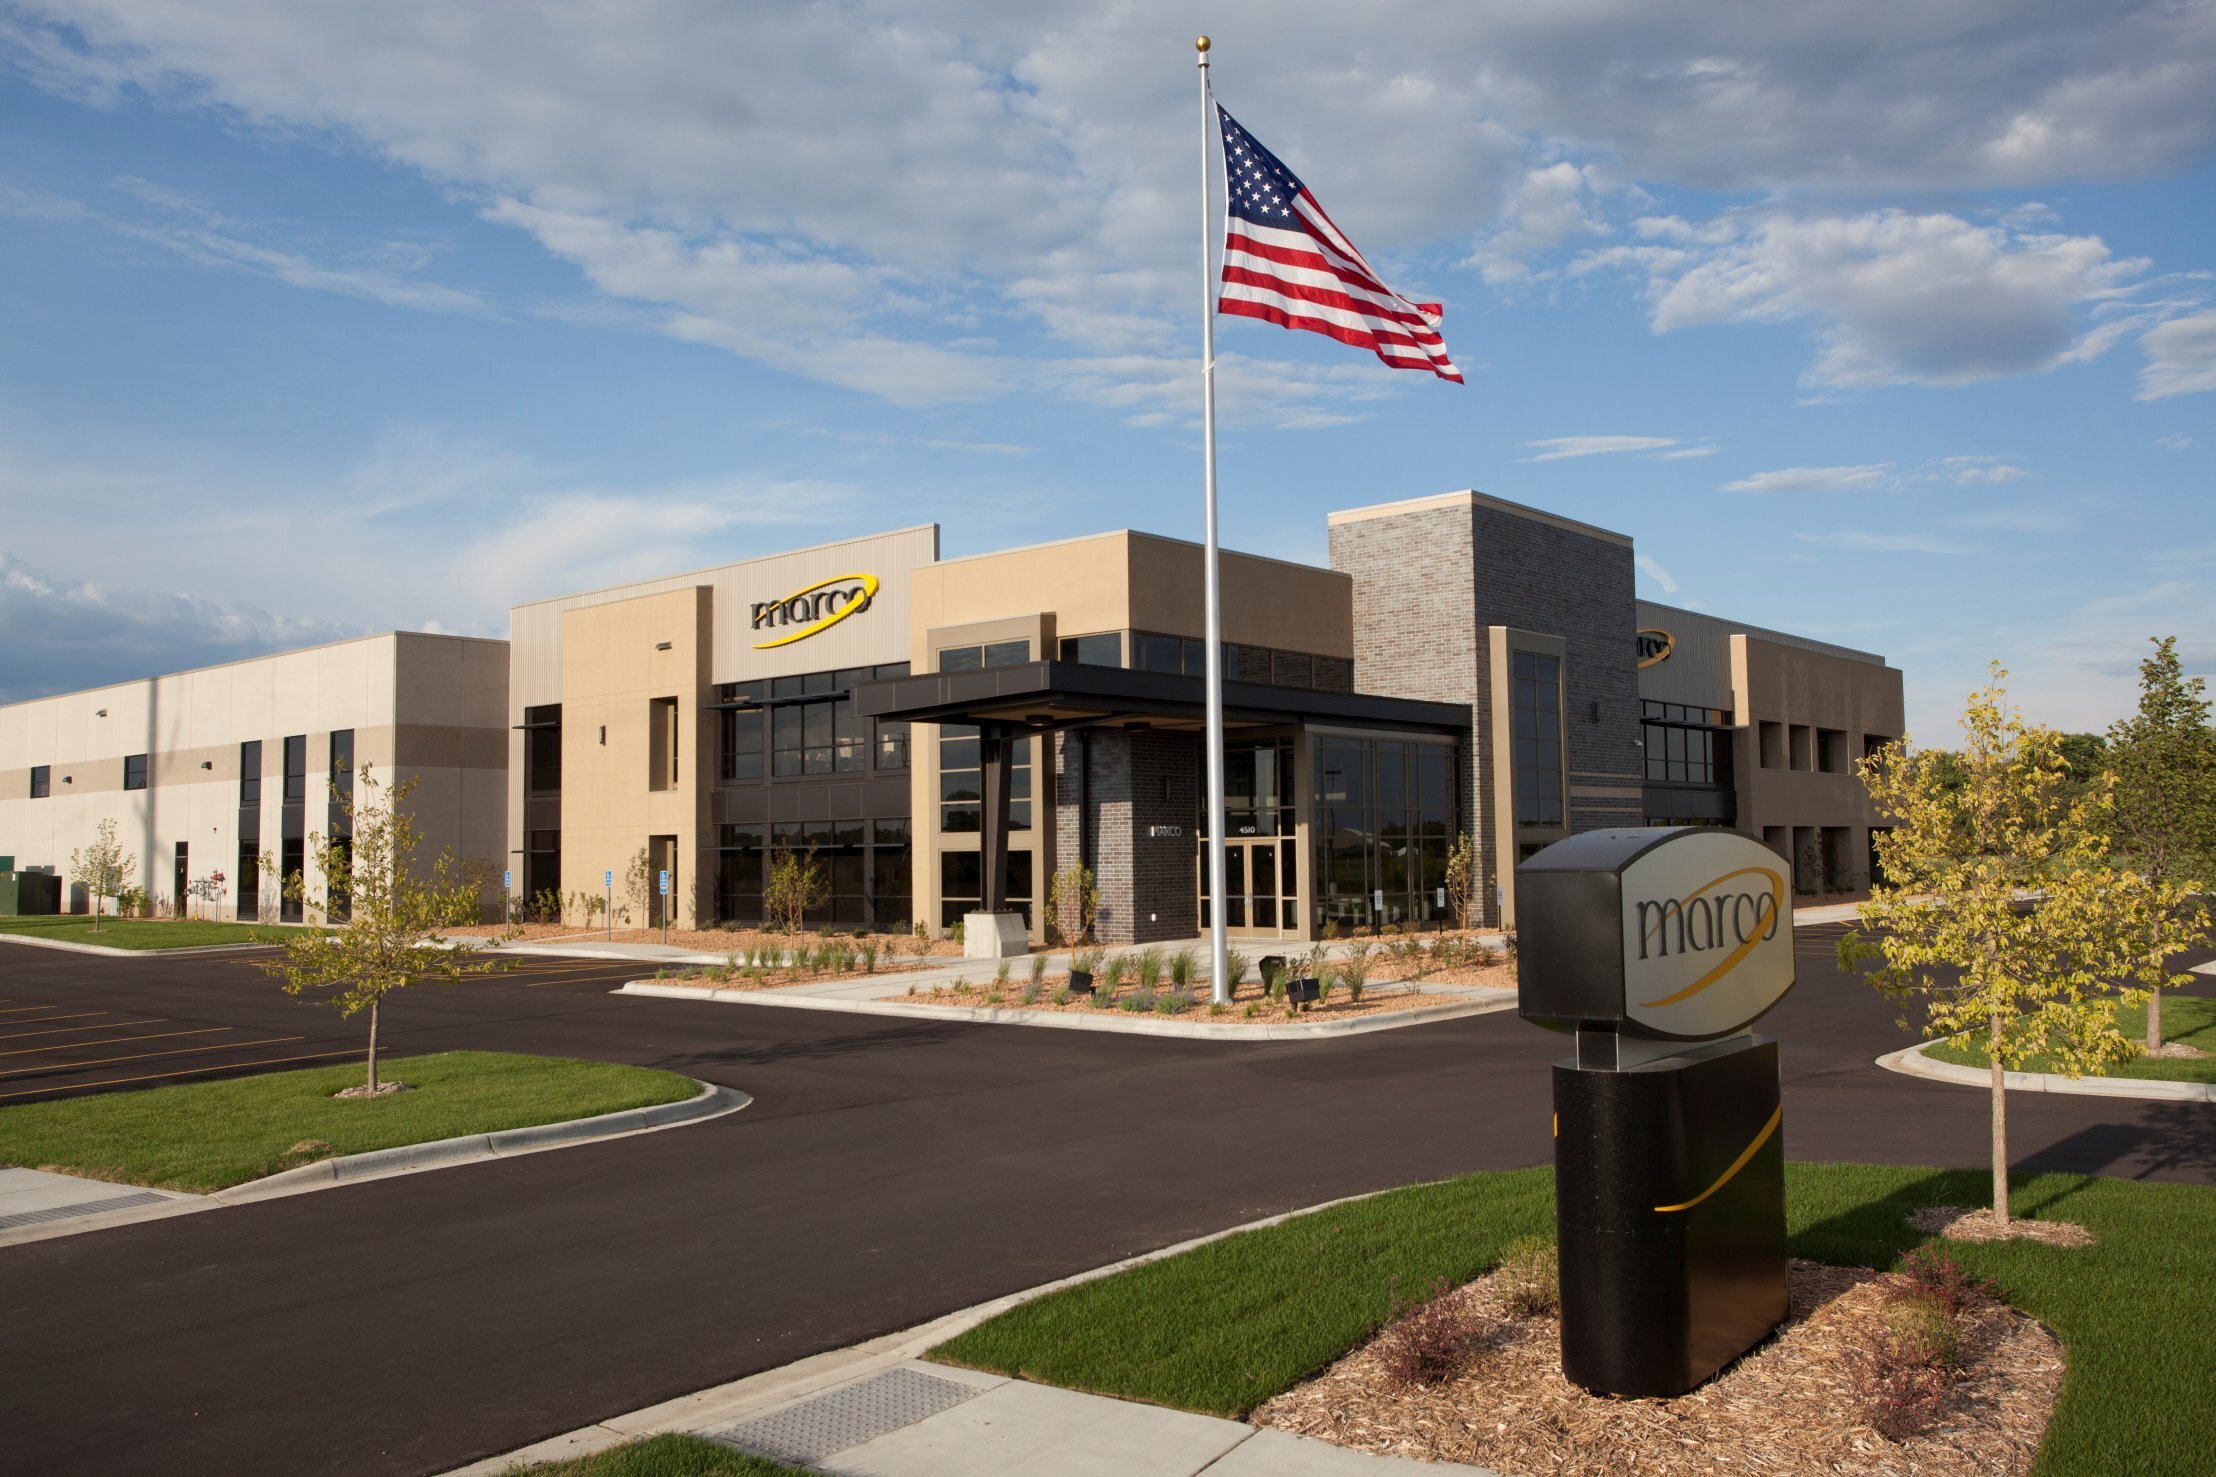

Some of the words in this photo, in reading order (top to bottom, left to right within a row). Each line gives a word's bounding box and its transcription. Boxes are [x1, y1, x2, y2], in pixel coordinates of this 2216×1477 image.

[750, 586, 872, 630] marco
[1151, 825, 1182, 837] MARCO
[1239, 825, 1256, 834] 4510
[1635, 891, 1778, 960] marco
